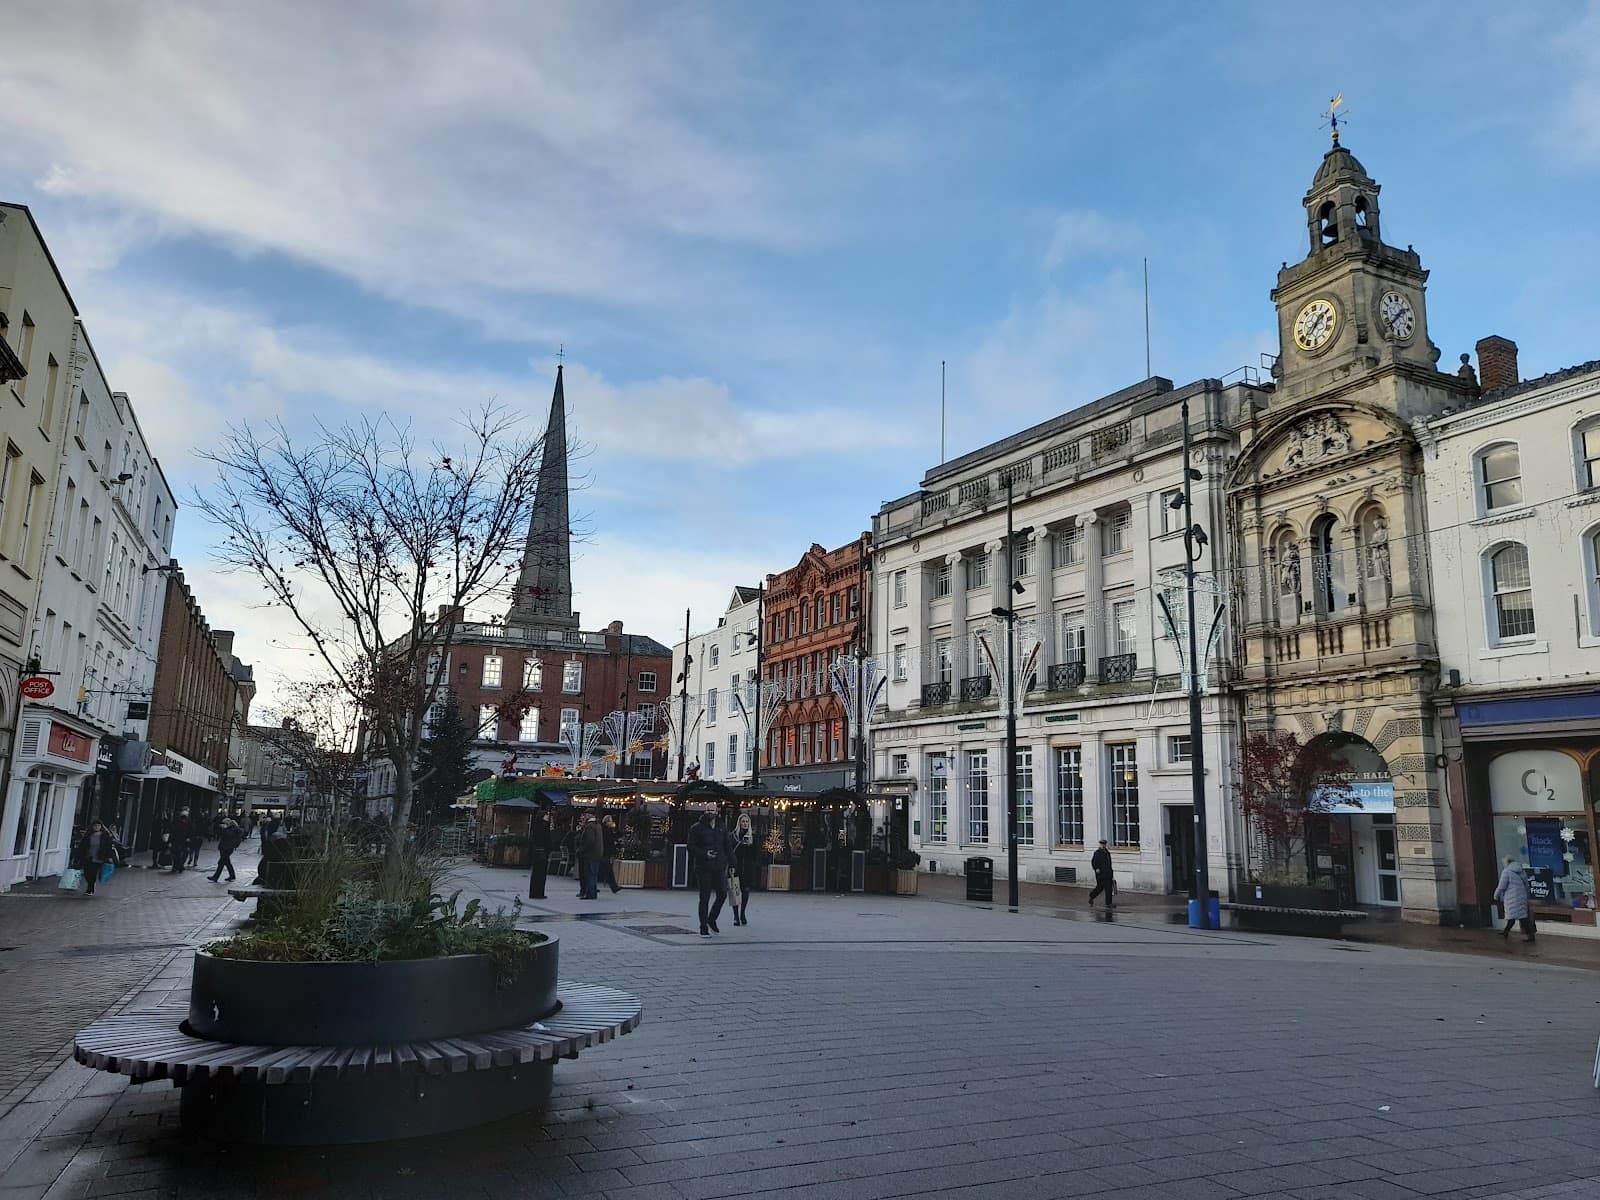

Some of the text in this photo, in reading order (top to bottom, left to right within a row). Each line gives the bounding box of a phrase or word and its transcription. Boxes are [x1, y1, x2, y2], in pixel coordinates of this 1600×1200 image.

[1363, 771, 1391, 780] HALL
[1360, 788, 1370, 797] to
[1373, 785, 1389, 797] the
[1530, 887, 1550, 897] Friday
